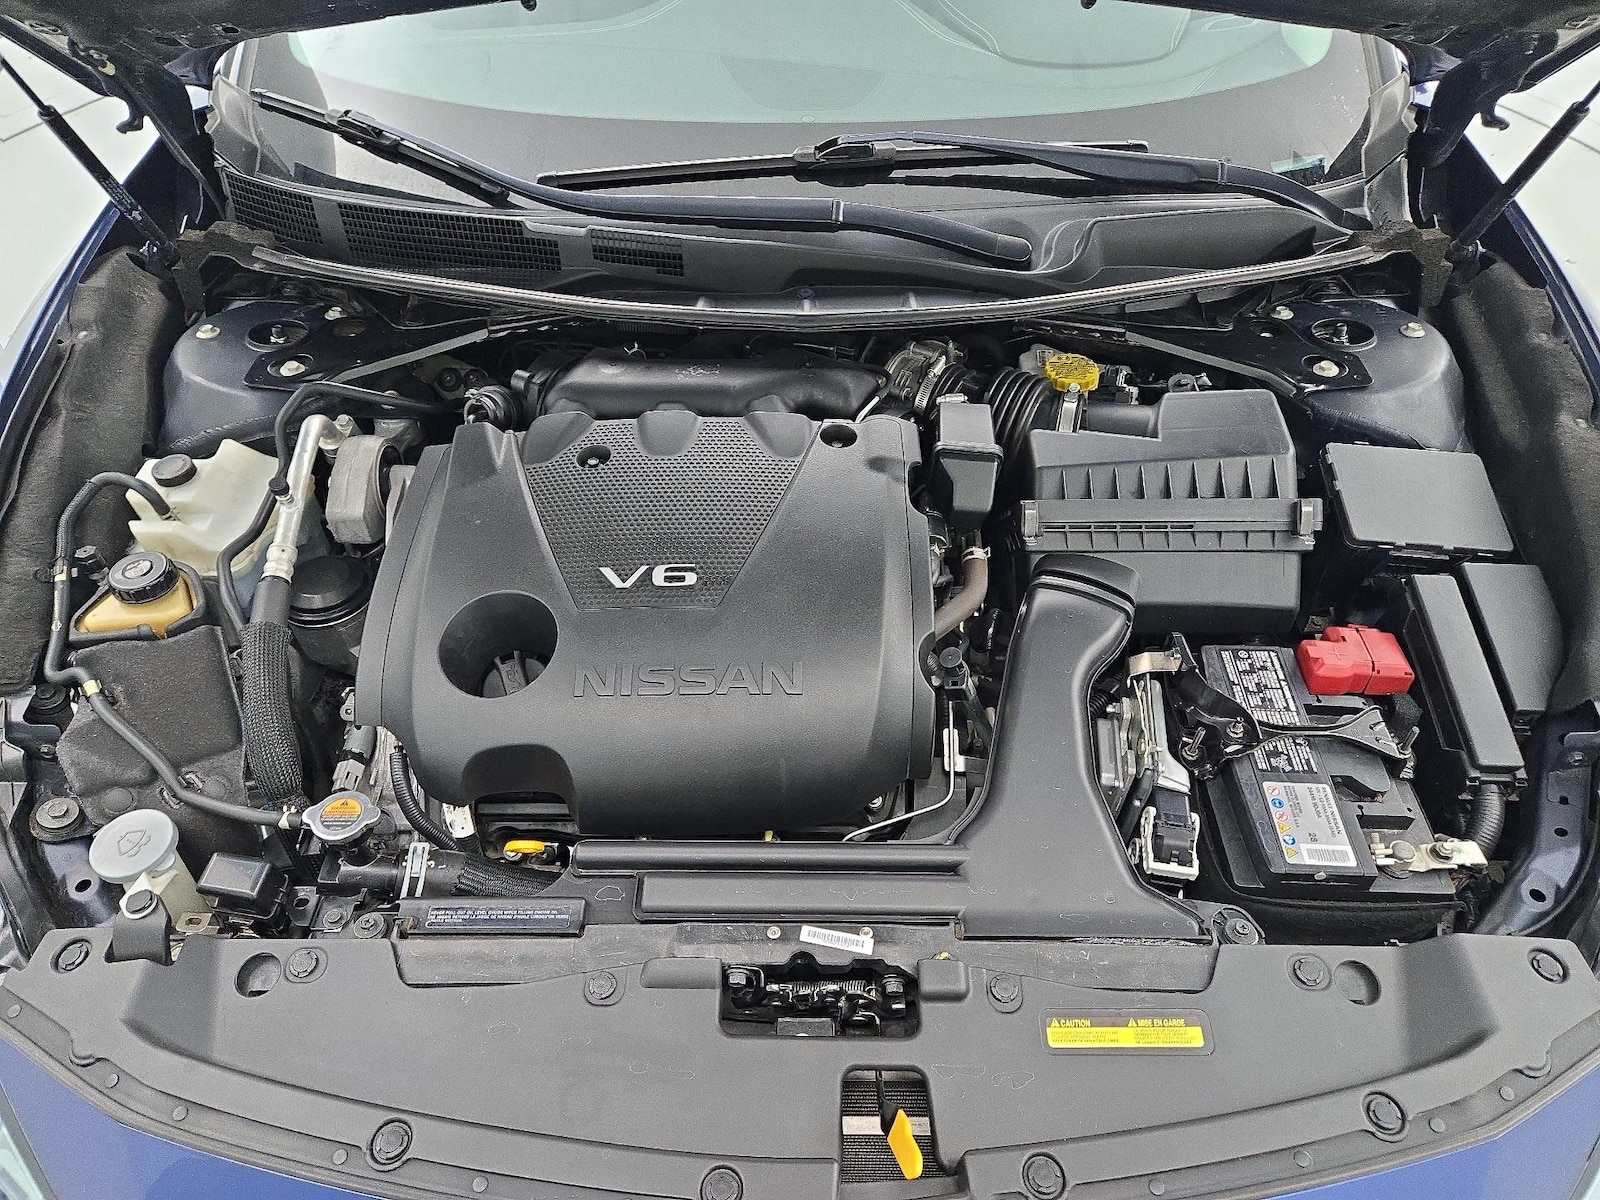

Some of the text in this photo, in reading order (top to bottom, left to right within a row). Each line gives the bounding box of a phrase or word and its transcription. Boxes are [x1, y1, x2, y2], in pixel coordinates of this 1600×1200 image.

[599, 563, 698, 589] V6
[573, 660, 803, 697] NISSAN
[1328, 810, 1343, 834] NISSAN
[1060, 1019, 1091, 1027] CAUTION
[1137, 1019, 1186, 1027] MISE EN GARDE
